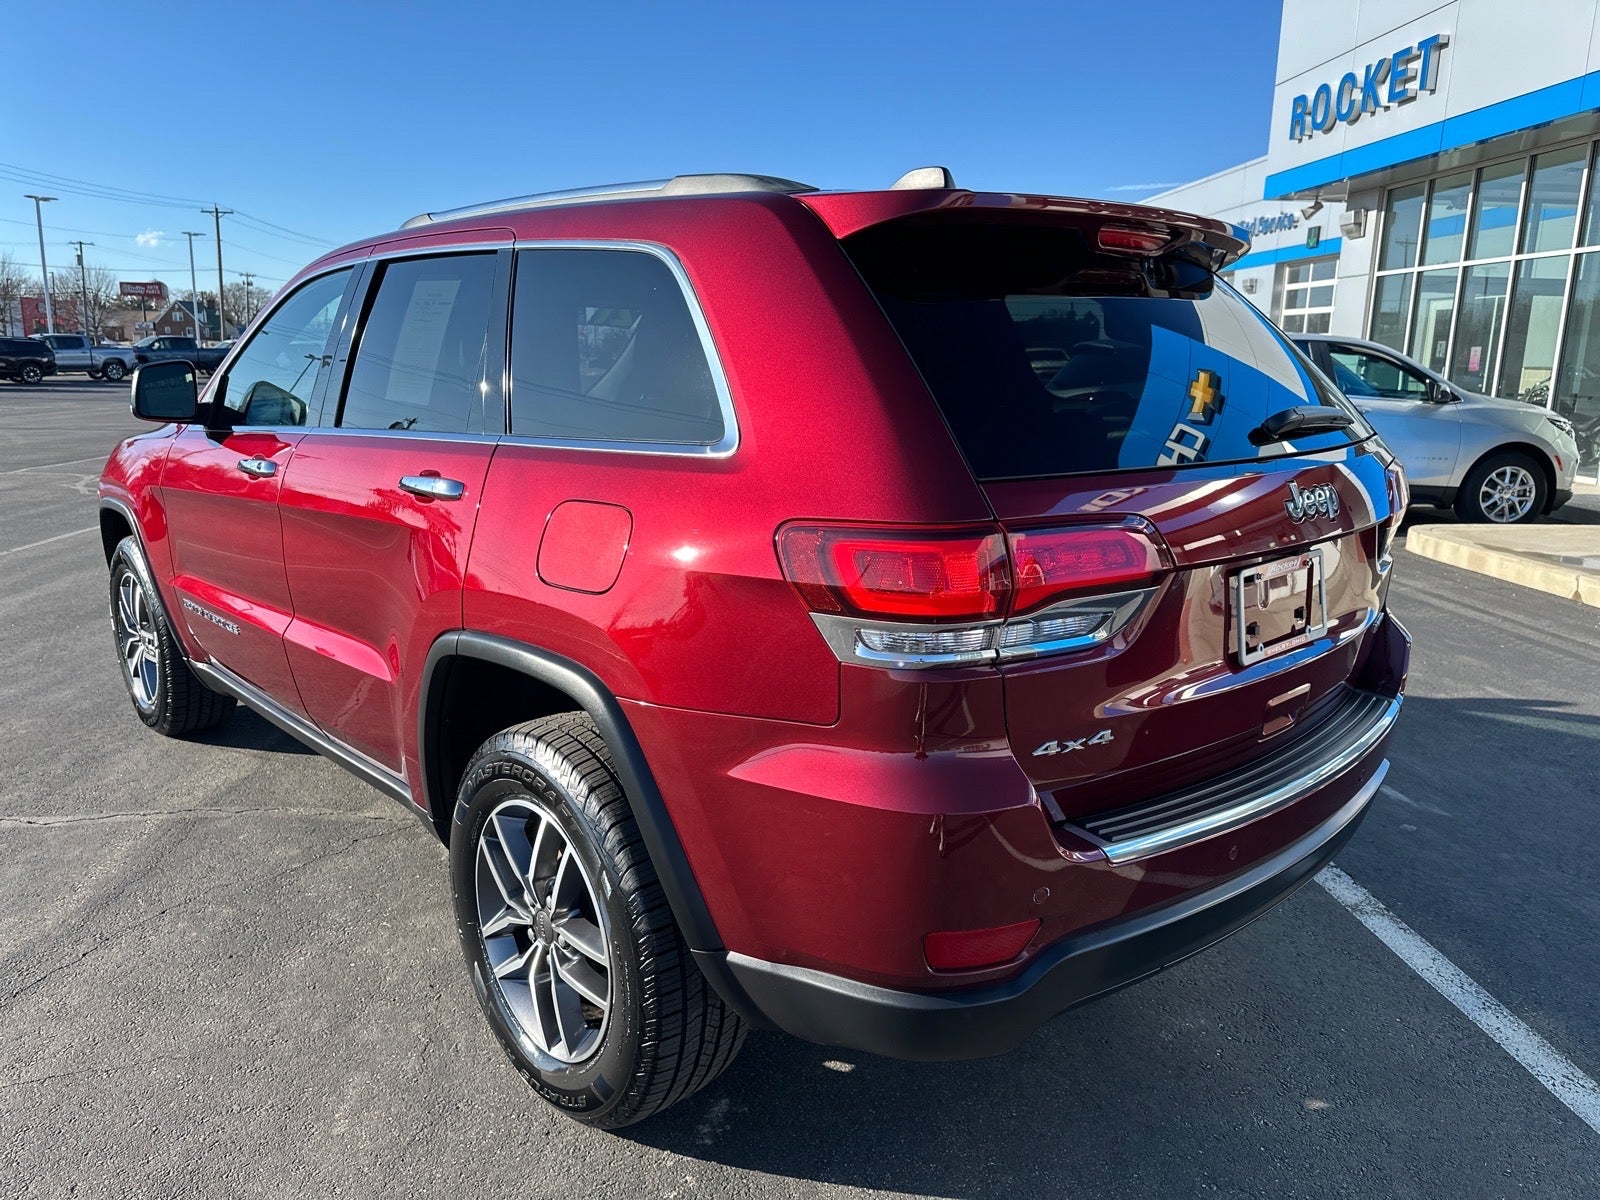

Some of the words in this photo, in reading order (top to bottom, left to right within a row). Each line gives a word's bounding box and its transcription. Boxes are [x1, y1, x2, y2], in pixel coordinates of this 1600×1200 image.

[1289, 34, 1449, 141] ROCKET
[1285, 480, 1339, 523] Jeep
[1032, 729, 1114, 756] 4x4
[467, 761, 584, 836] MASTERCRAFT
